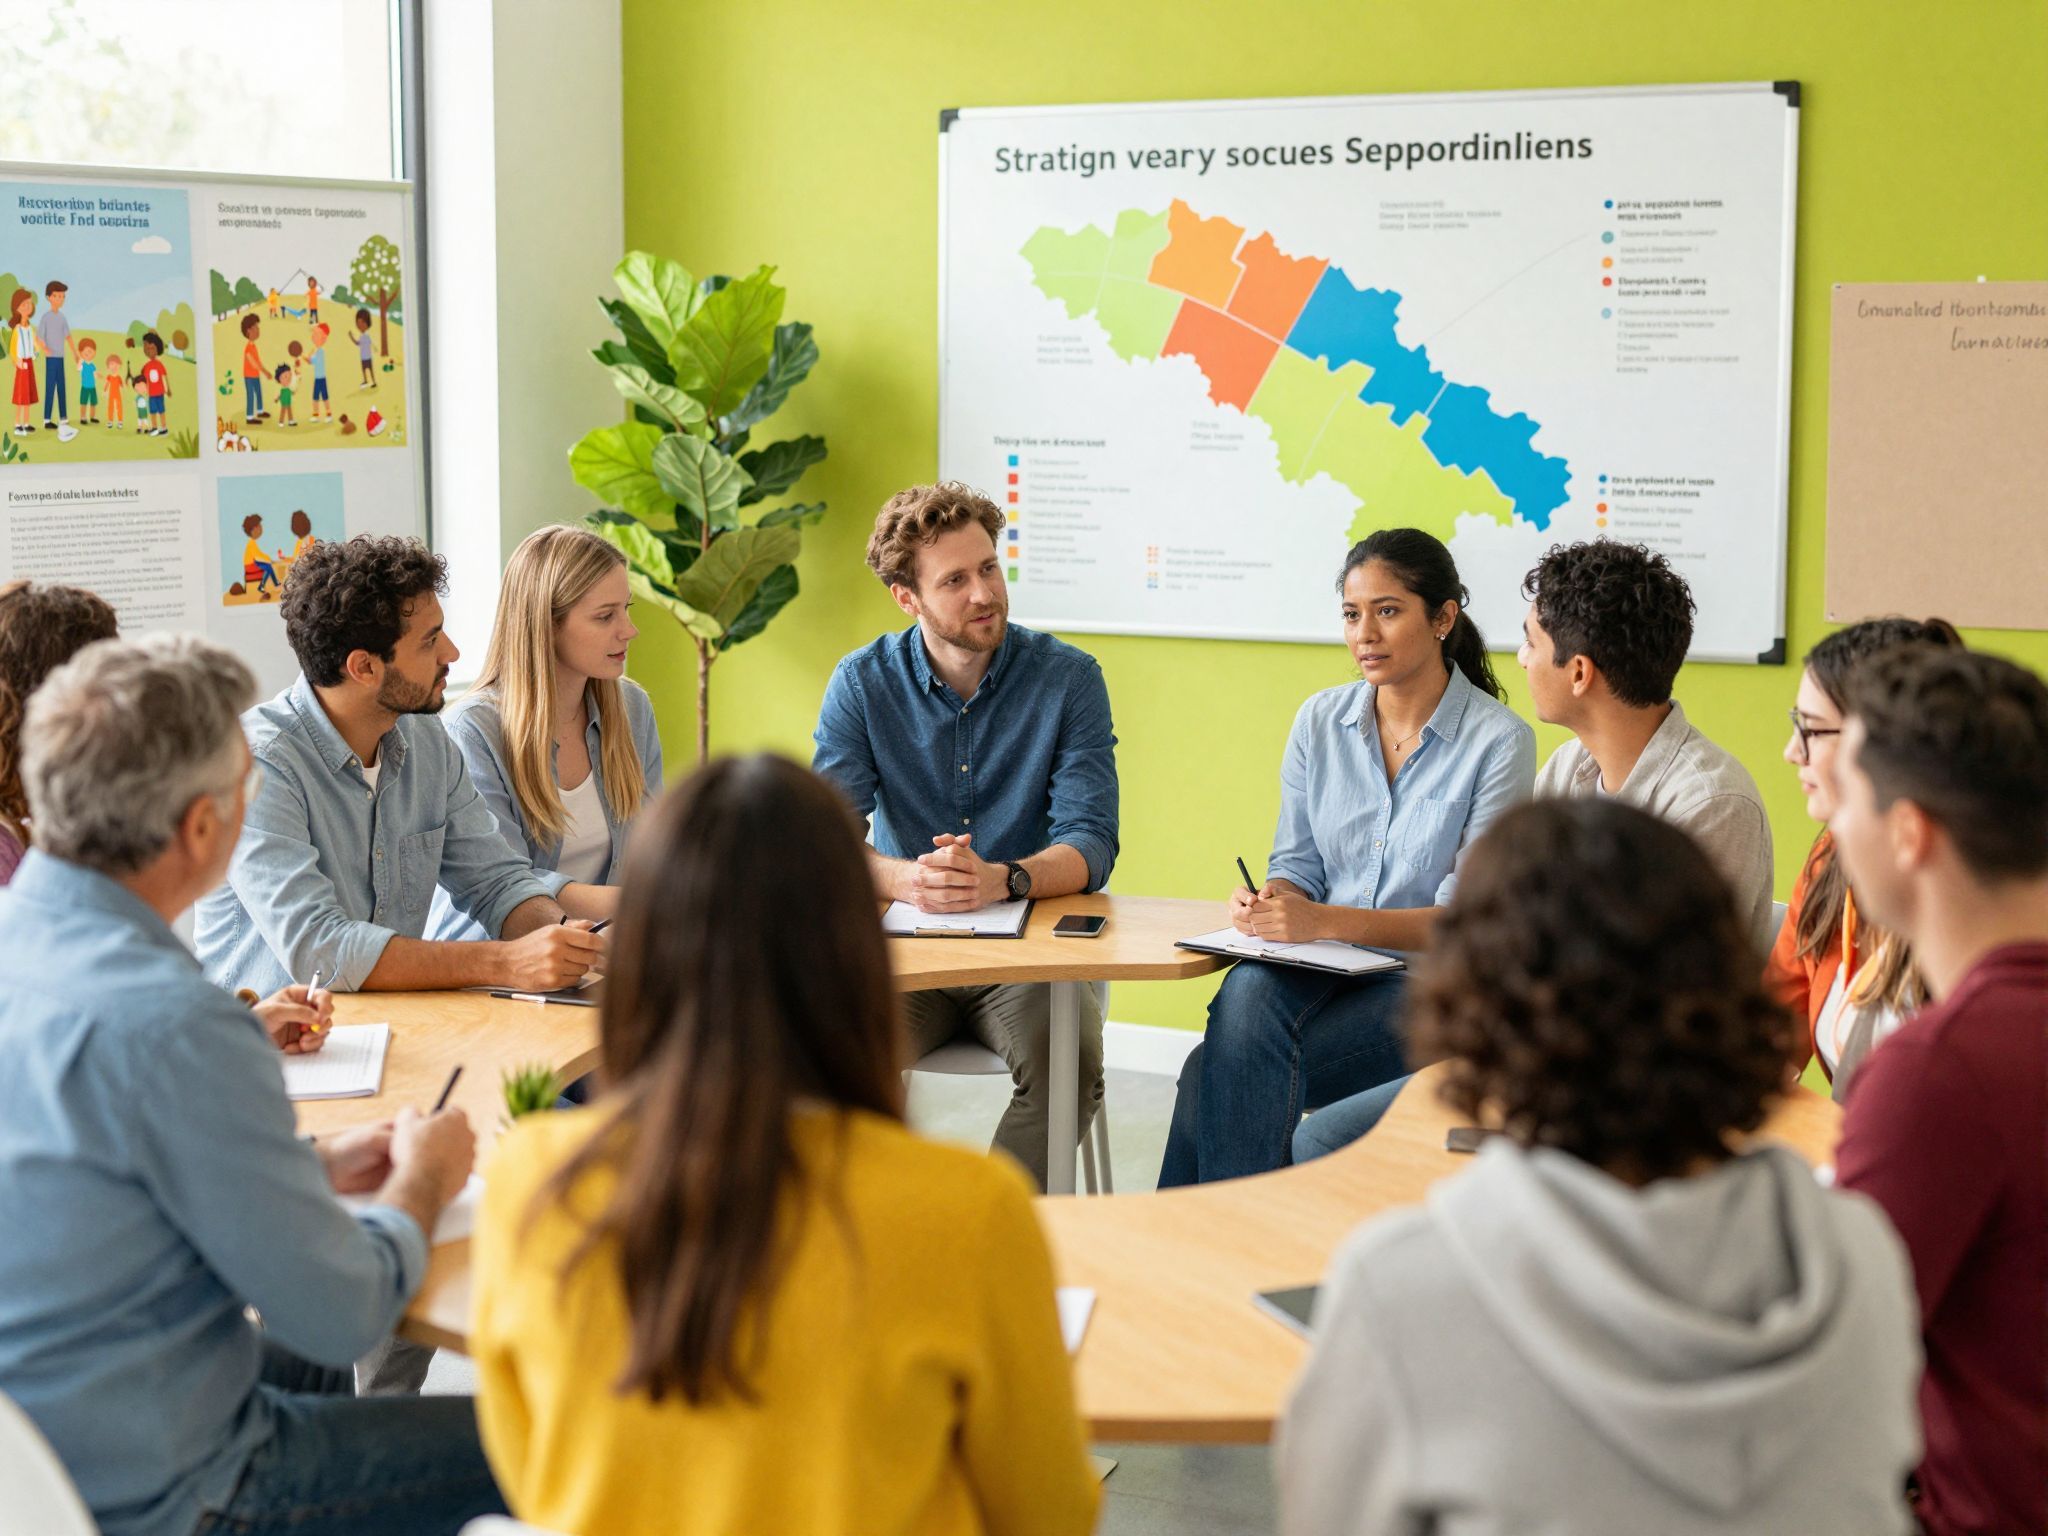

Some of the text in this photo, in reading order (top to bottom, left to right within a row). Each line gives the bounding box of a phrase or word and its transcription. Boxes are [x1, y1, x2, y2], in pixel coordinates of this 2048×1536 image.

[995, 132, 1594, 178] Stratign veary socues Seppordinliens
